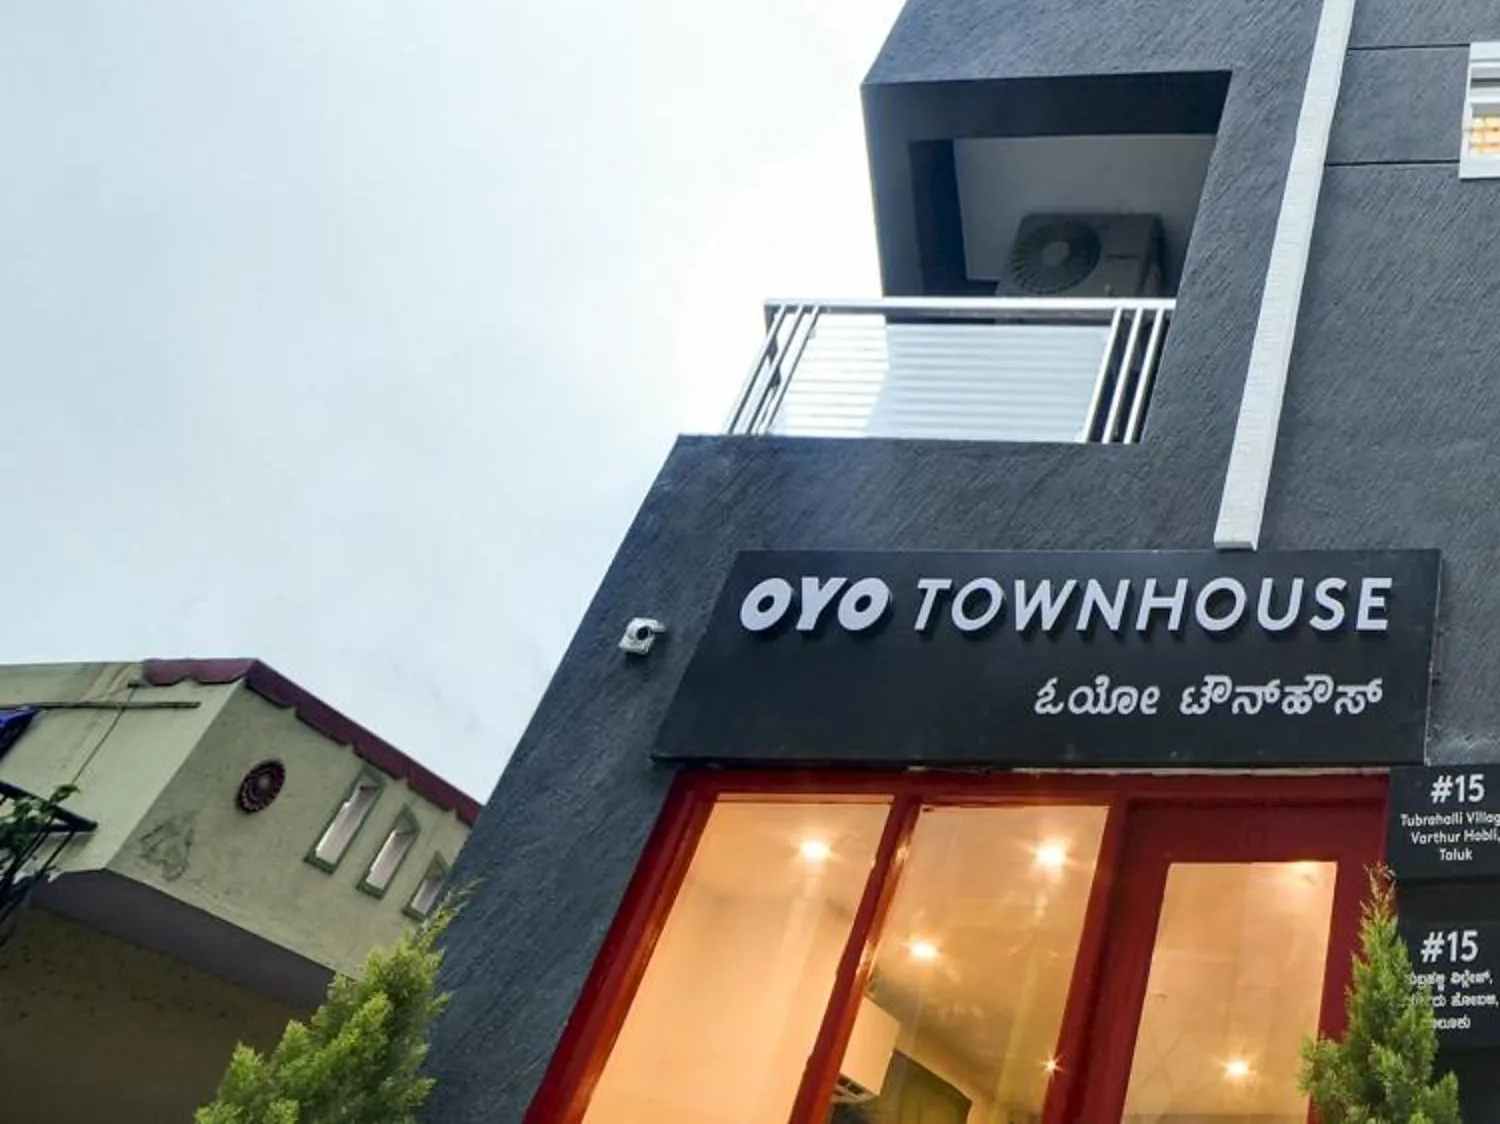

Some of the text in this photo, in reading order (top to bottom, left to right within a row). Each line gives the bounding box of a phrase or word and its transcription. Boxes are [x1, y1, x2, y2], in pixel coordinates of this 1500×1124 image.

[740, 576, 1393, 632] OYO TOWNHOUSE
[1034, 674, 1161, 715] ಓಯೋ
[1430, 773, 1486, 804] #15
[1400, 812, 1463, 827] Tubrahalli
[1411, 831, 1461, 845] Varthur
[1439, 847, 1473, 861] Taluk
[1420, 929, 1479, 963] #15
